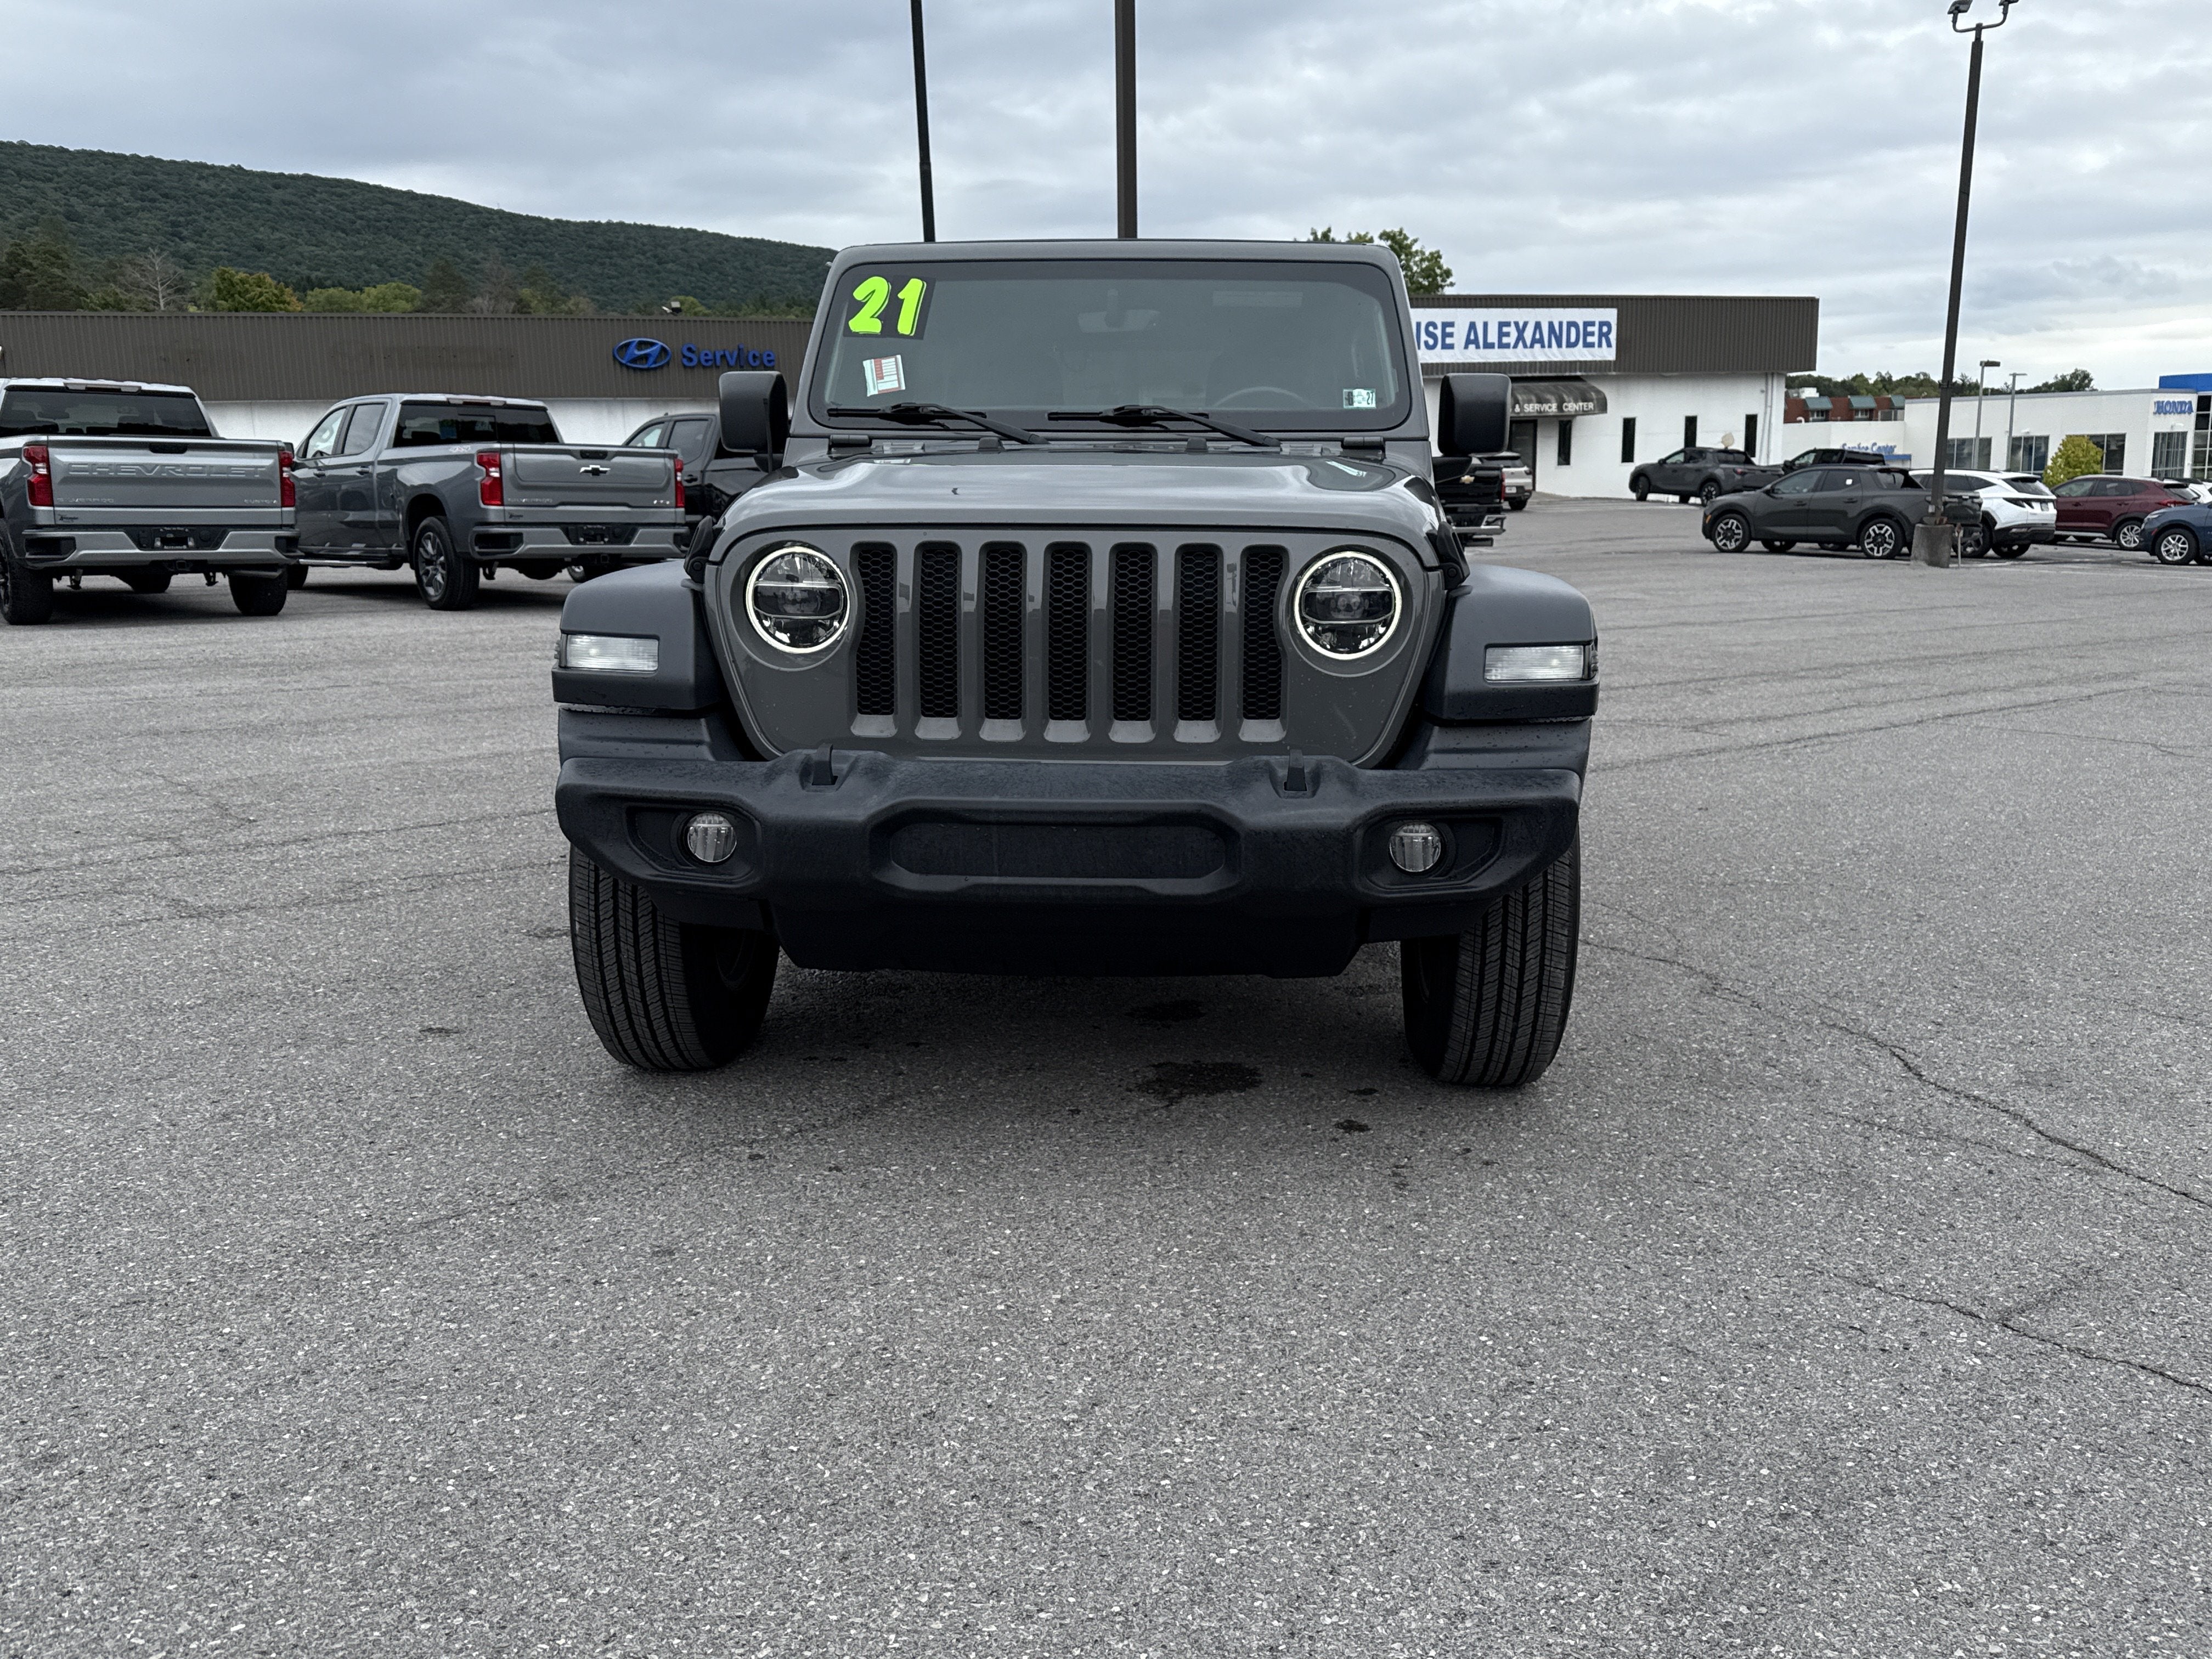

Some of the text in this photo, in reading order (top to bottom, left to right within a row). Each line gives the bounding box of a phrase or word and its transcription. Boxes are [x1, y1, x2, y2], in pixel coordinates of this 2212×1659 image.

[849, 276, 927, 336] 21
[1464, 321, 1613, 350] ALEXANDER
[681, 343, 776, 367] Service
[1514, 402, 1594, 413] & SERVICE CENTER
[2154, 400, 2194, 414] HONDA
[68, 464, 266, 477] CHEVROLET
